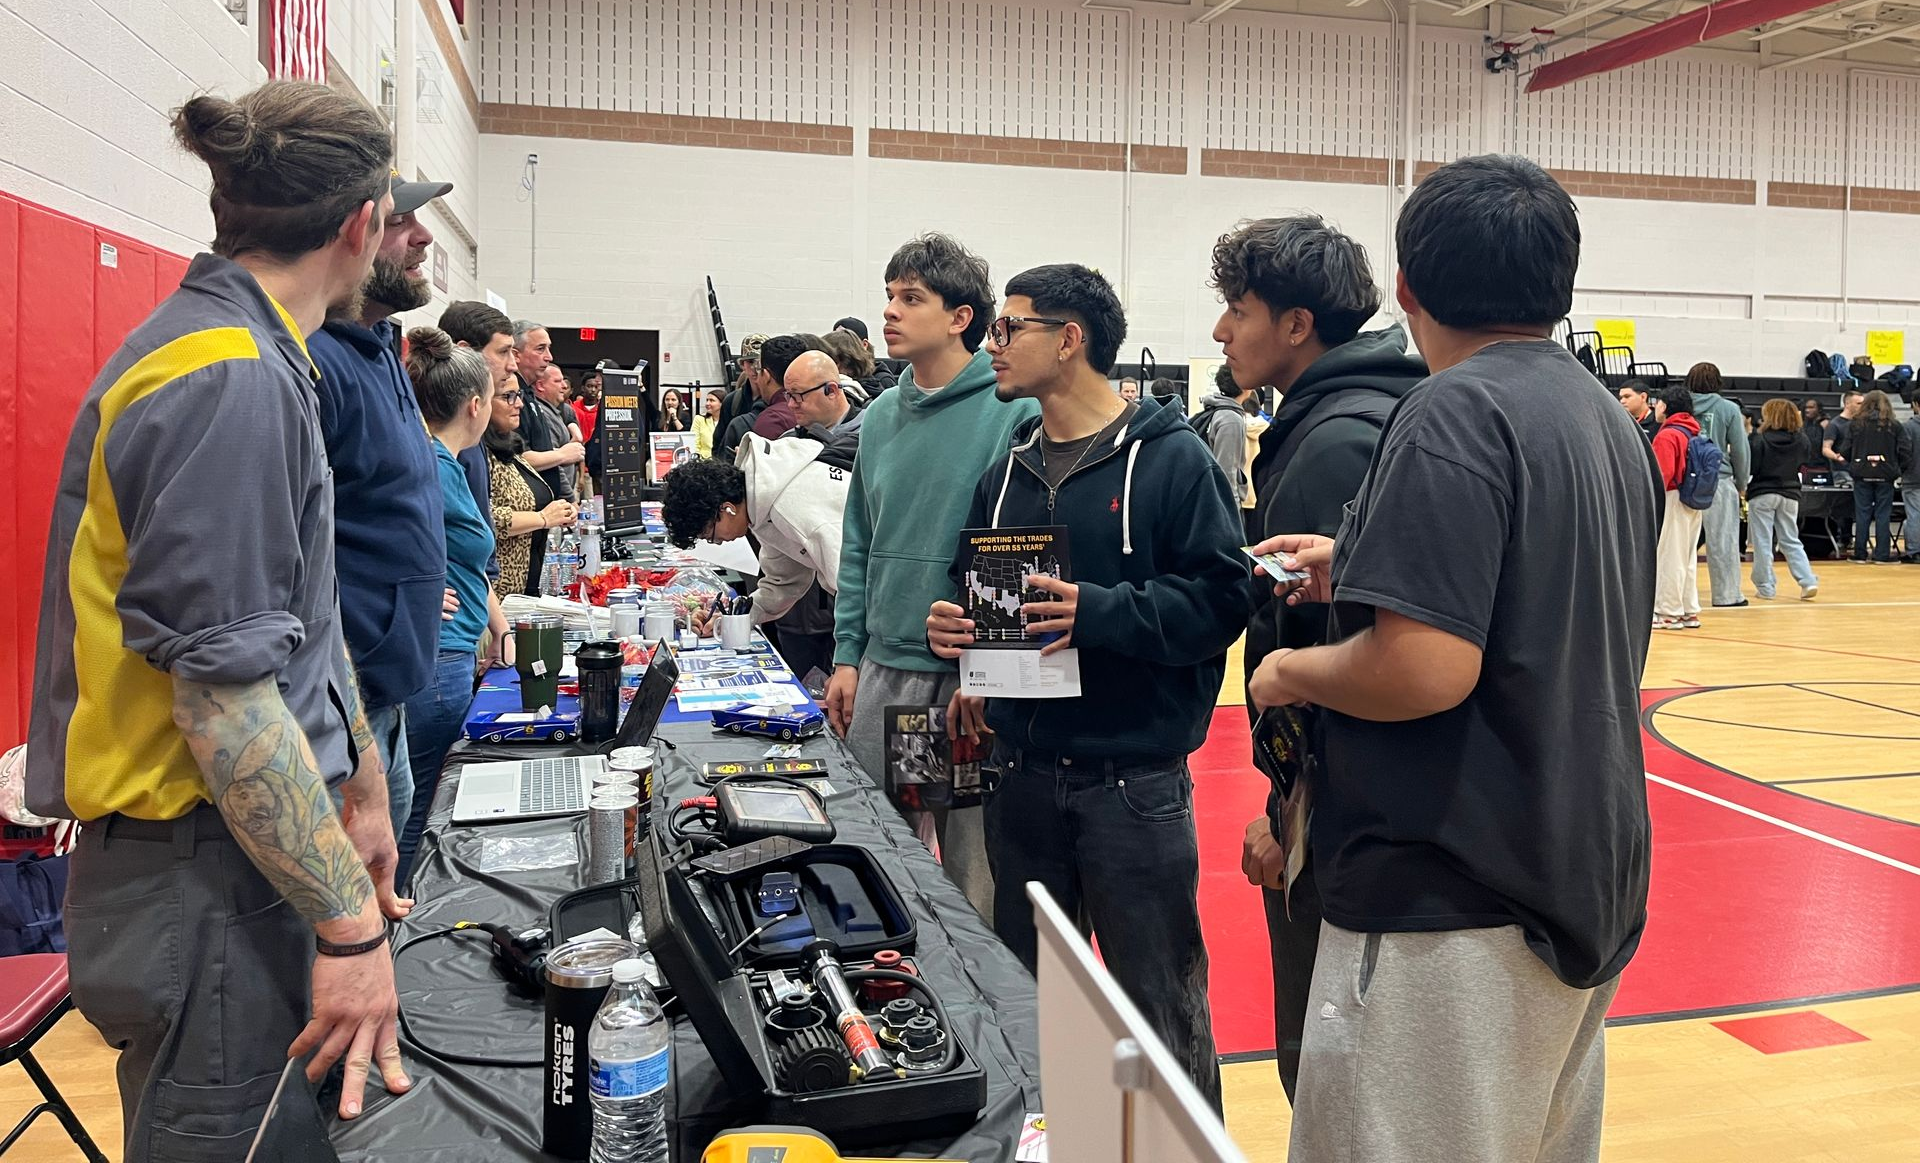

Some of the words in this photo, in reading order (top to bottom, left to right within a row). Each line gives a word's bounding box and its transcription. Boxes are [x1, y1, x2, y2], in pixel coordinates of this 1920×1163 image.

[580, 328, 596, 341] EXIT
[605, 395, 623, 408] PASSION
[624, 395, 638, 409] MEETS
[970, 536, 1012, 544] SUPPORTING
[1013, 535, 1026, 543] THE
[1027, 534, 1053, 542] TRADES
[992, 544, 1011, 552] OVER
[552, 1022, 562, 1105] nokian
[561, 1025, 575, 1106] TYRES
